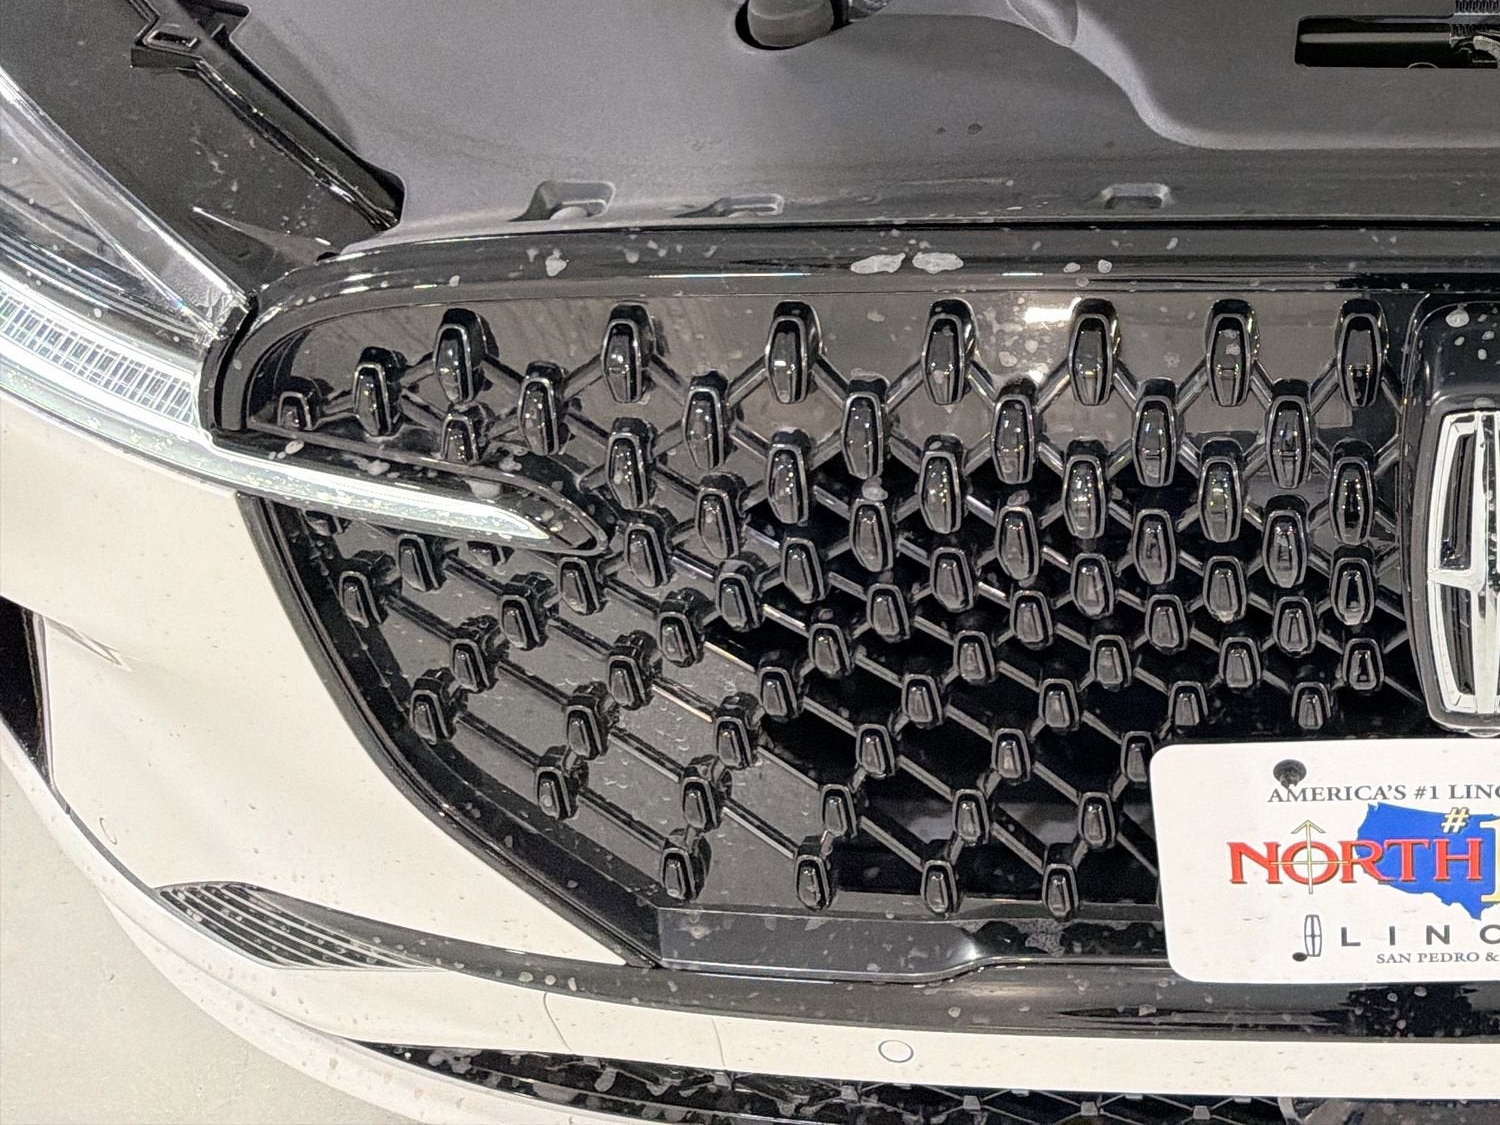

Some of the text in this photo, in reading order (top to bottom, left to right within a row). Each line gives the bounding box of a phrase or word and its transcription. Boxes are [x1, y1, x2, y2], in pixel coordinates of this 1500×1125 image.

[1267, 784, 1407, 803] AMERICA'S
[1414, 785, 1440, 800] #1
[1226, 838, 1483, 885] NORTH
[1376, 952, 1412, 964] SAN
[1418, 951, 1481, 963] PEDRO
[1485, 951, 1500, 963] &
